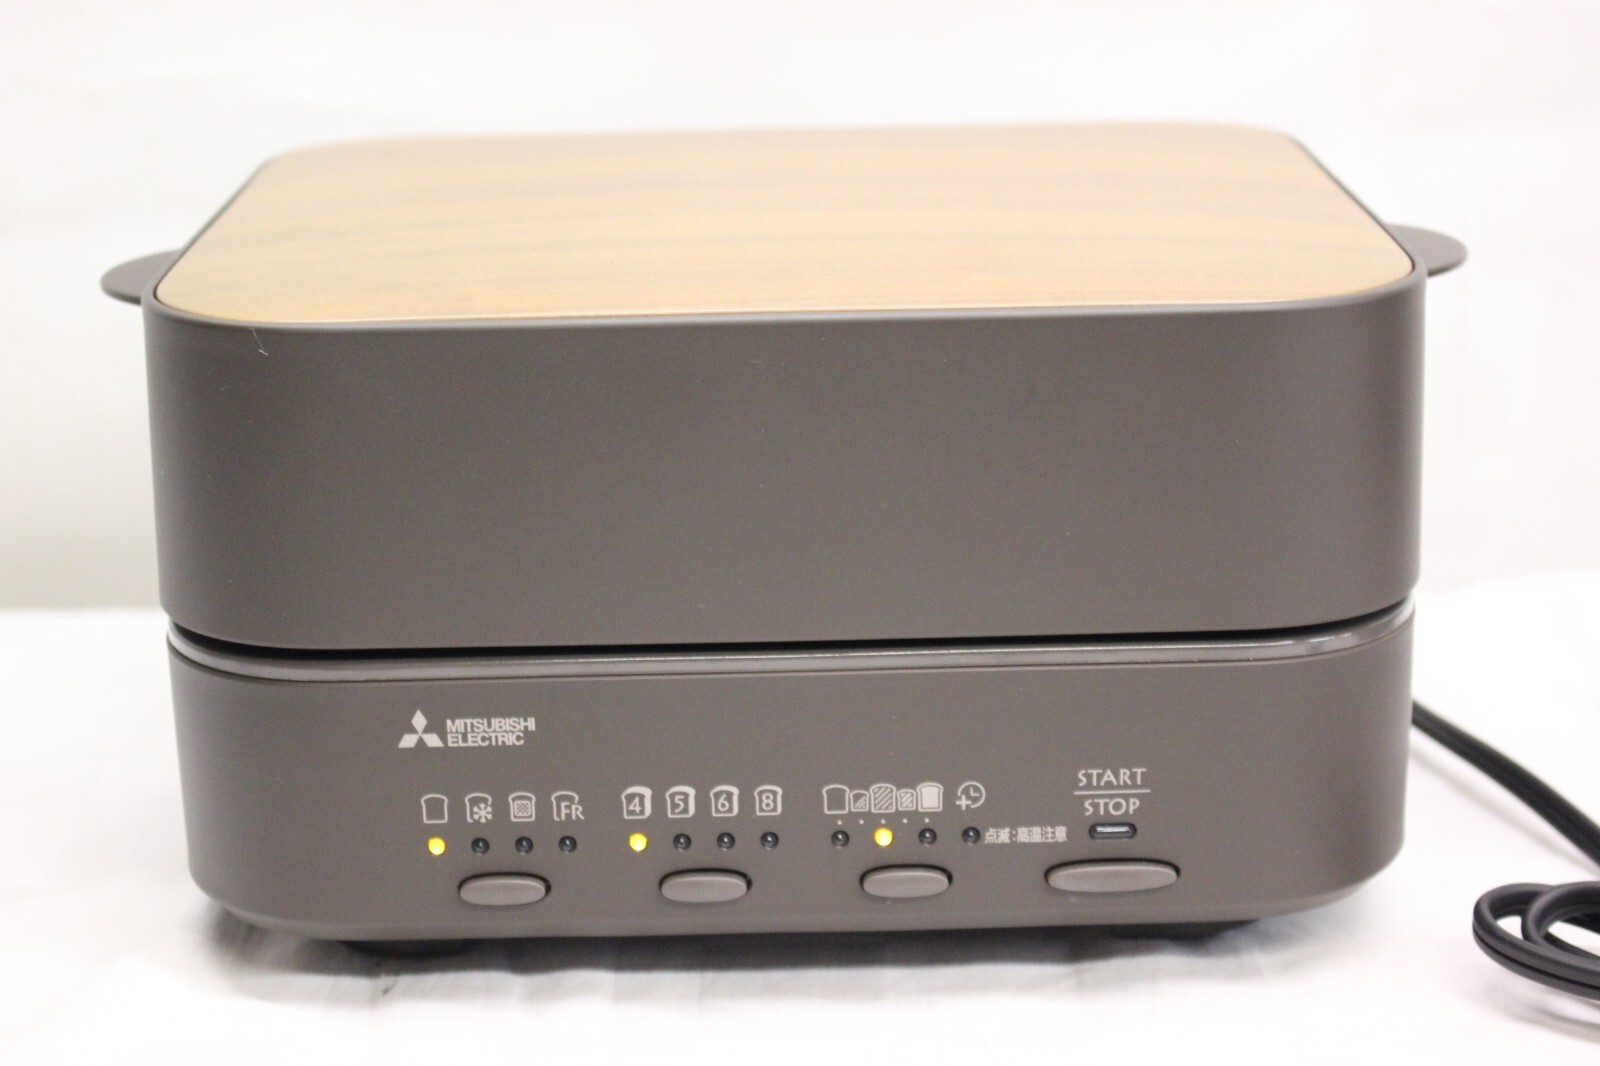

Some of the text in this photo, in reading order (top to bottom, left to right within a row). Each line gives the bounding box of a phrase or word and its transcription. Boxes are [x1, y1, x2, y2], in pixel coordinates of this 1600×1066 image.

[446, 717, 536, 733] MITSUBISHI
[447, 732, 525, 747] ELECTRIC
[1077, 768, 1147, 787] START
[560, 801, 585, 821] FR
[628, 792, 774, 814] 4 5 6 8
[1083, 798, 1141, 817] STOP
